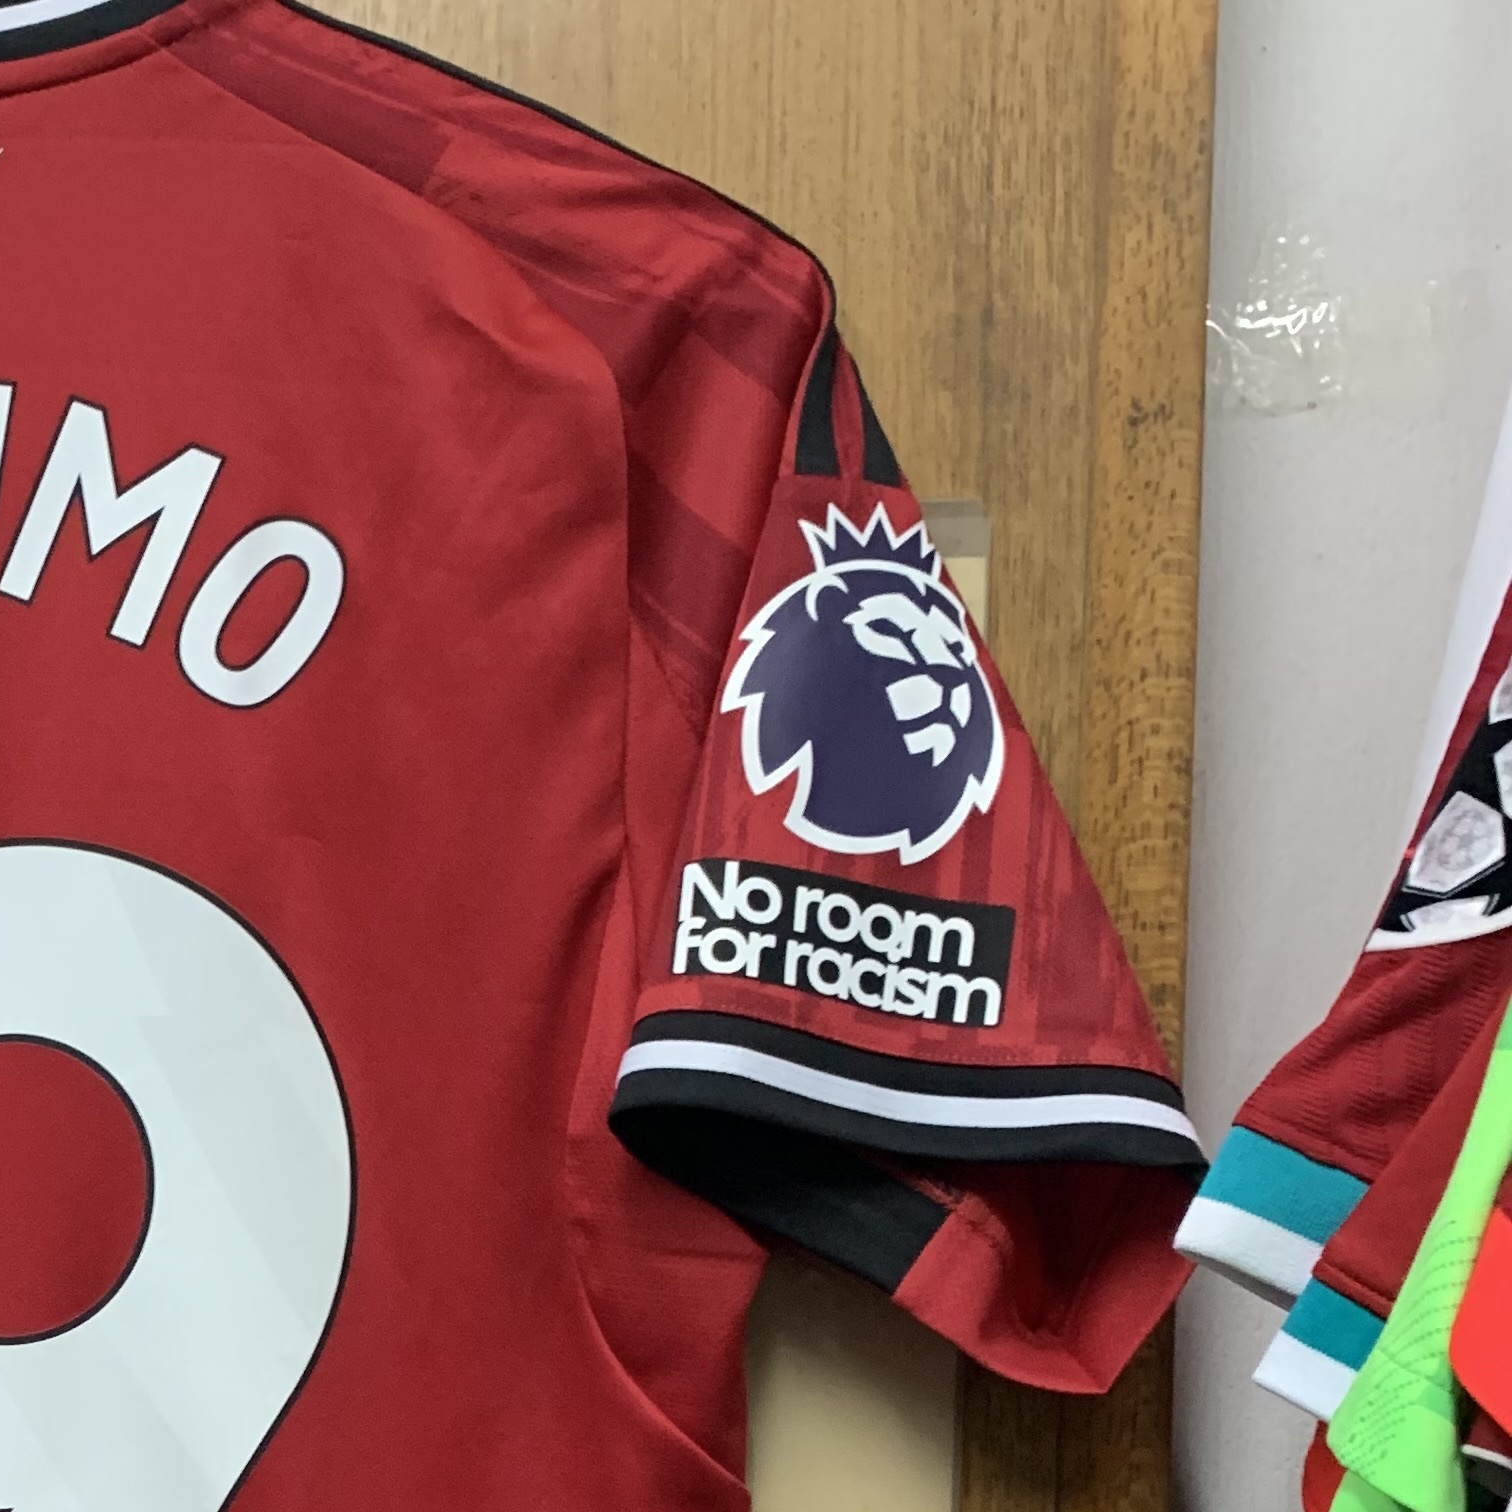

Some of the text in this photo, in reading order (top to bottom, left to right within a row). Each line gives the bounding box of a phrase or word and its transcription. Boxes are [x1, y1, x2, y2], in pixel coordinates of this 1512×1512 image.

[679, 861, 976, 967] No room
[672, 915, 1002, 1026] for racism
